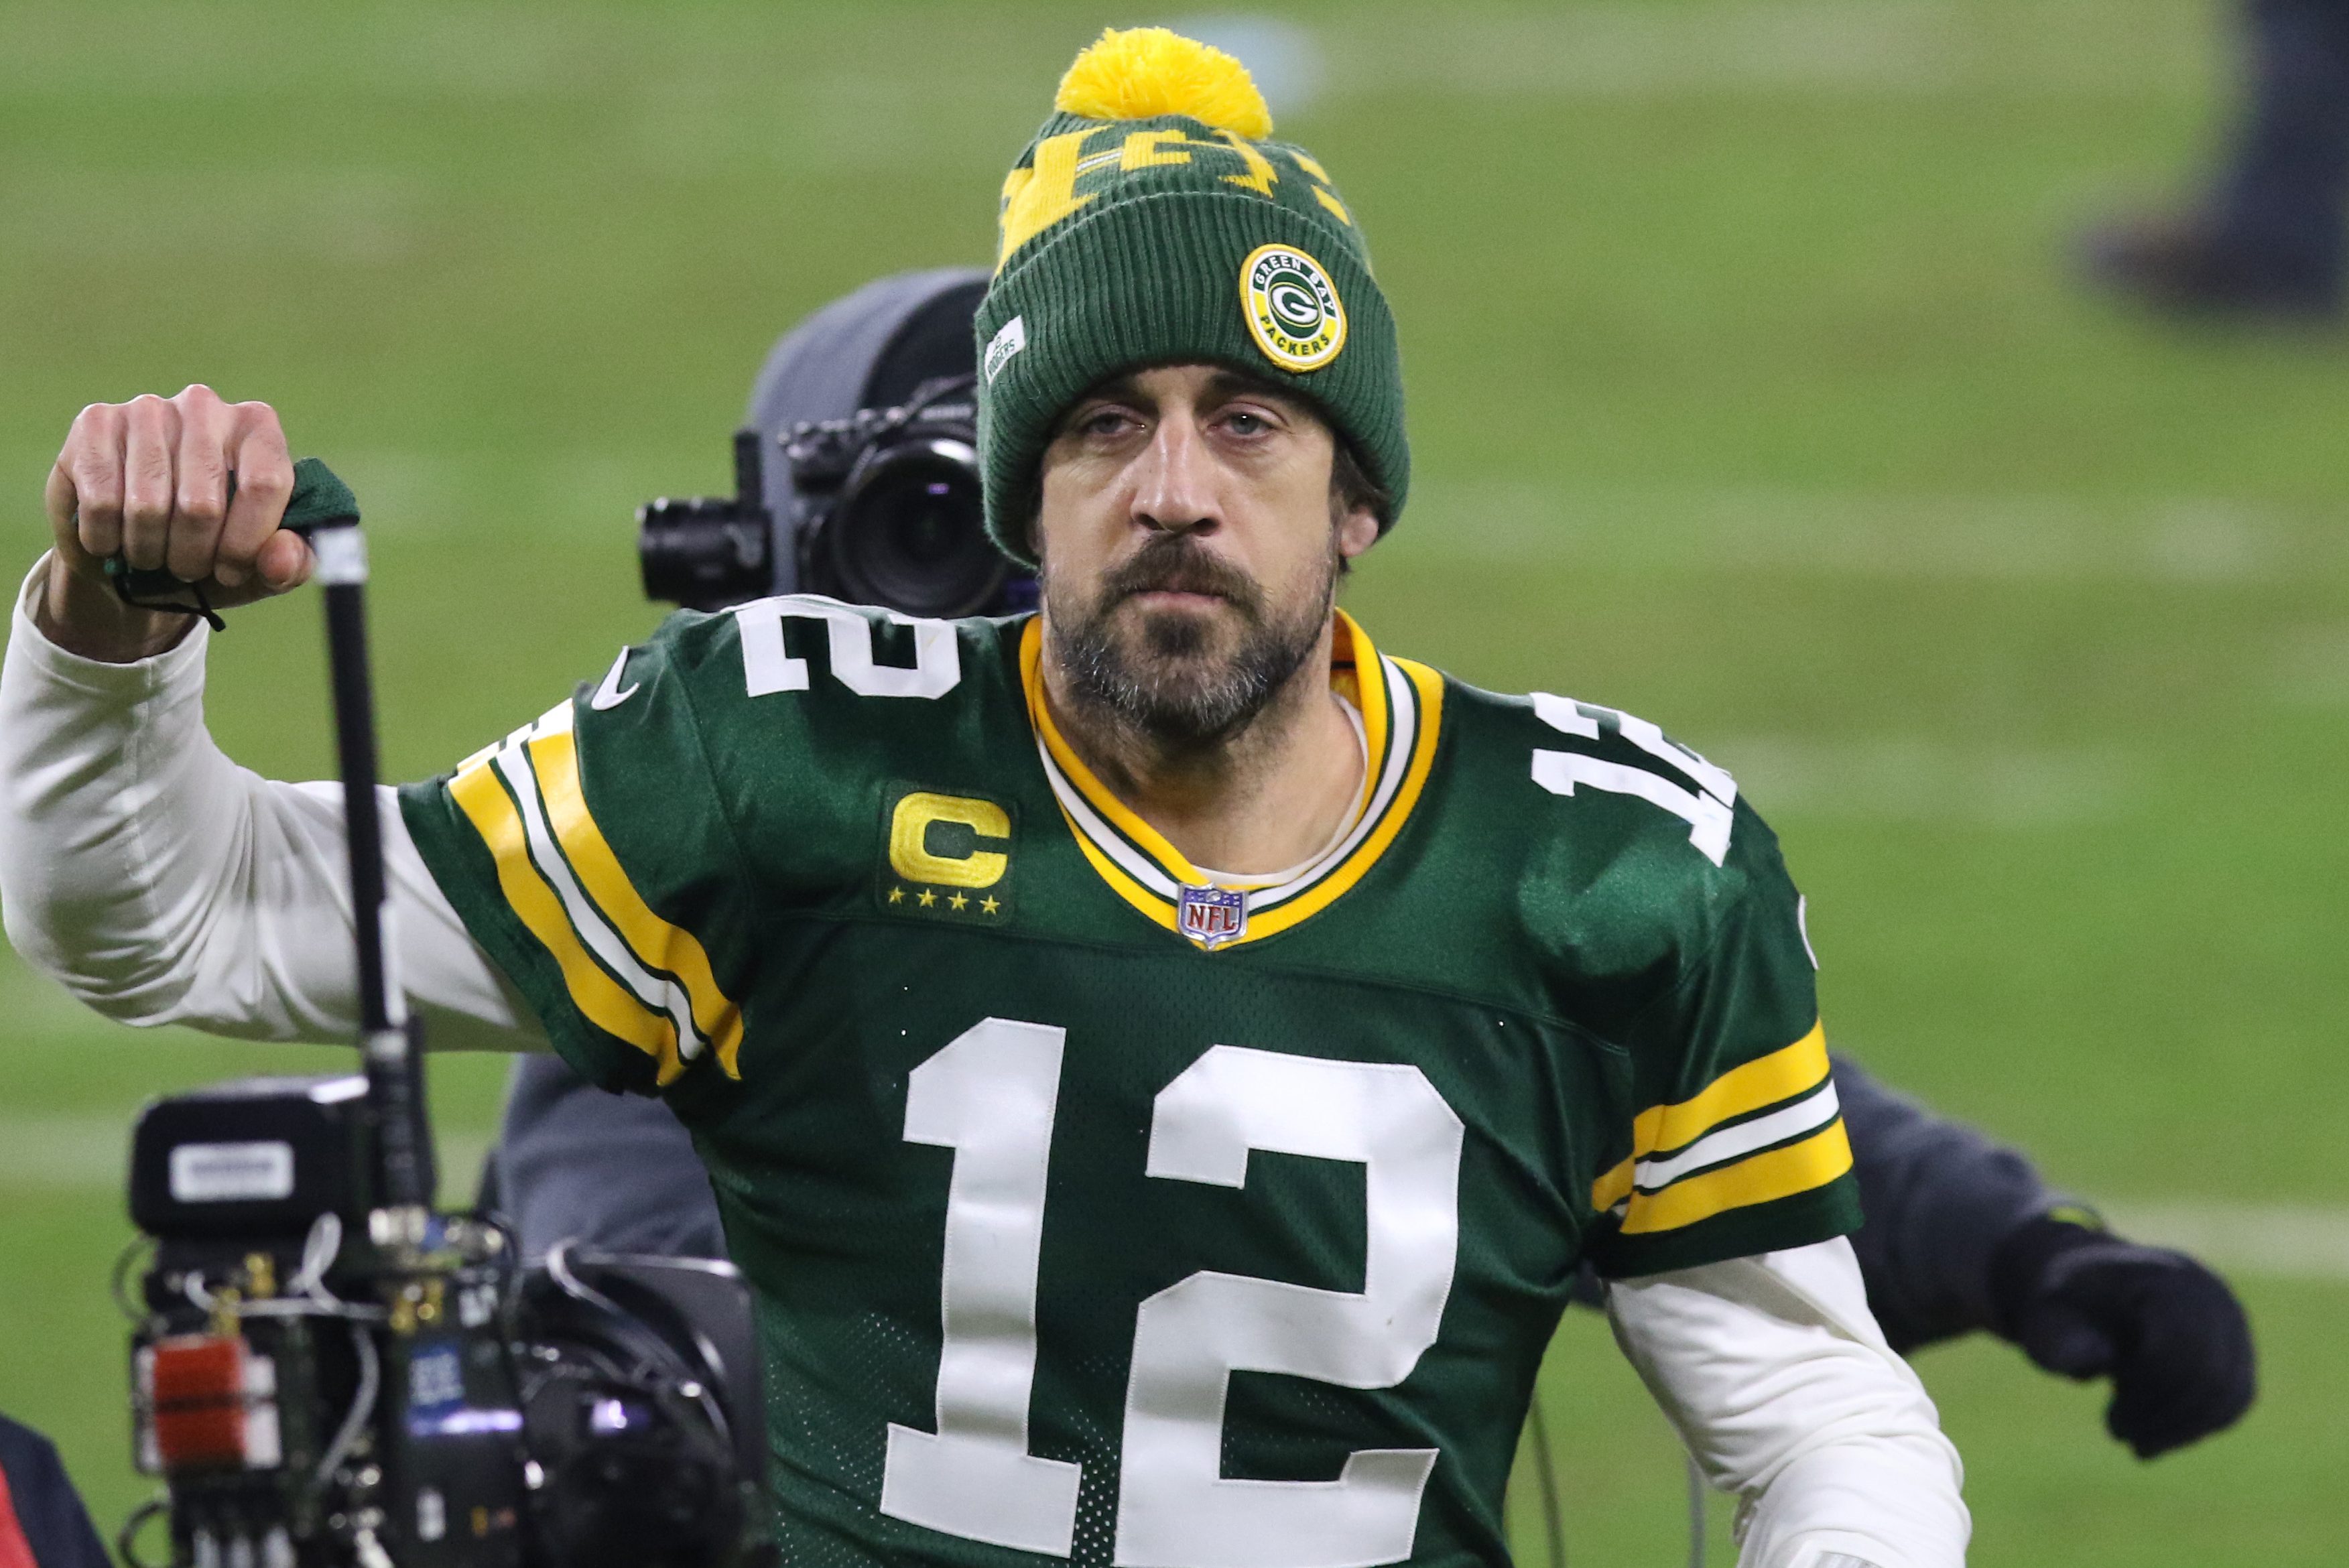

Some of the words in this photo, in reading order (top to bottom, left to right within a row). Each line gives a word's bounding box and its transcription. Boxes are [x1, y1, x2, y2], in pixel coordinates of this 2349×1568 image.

[1255, 255, 1302, 284] GREEN
[1309, 272, 1335, 311] BAY
[1271, 285, 1318, 324] G
[1261, 315, 1330, 356] PACKERS
[889, 791, 1011, 889] C
[1188, 904, 1238, 933] NFL
[880, 1016, 1466, 1567] 12
